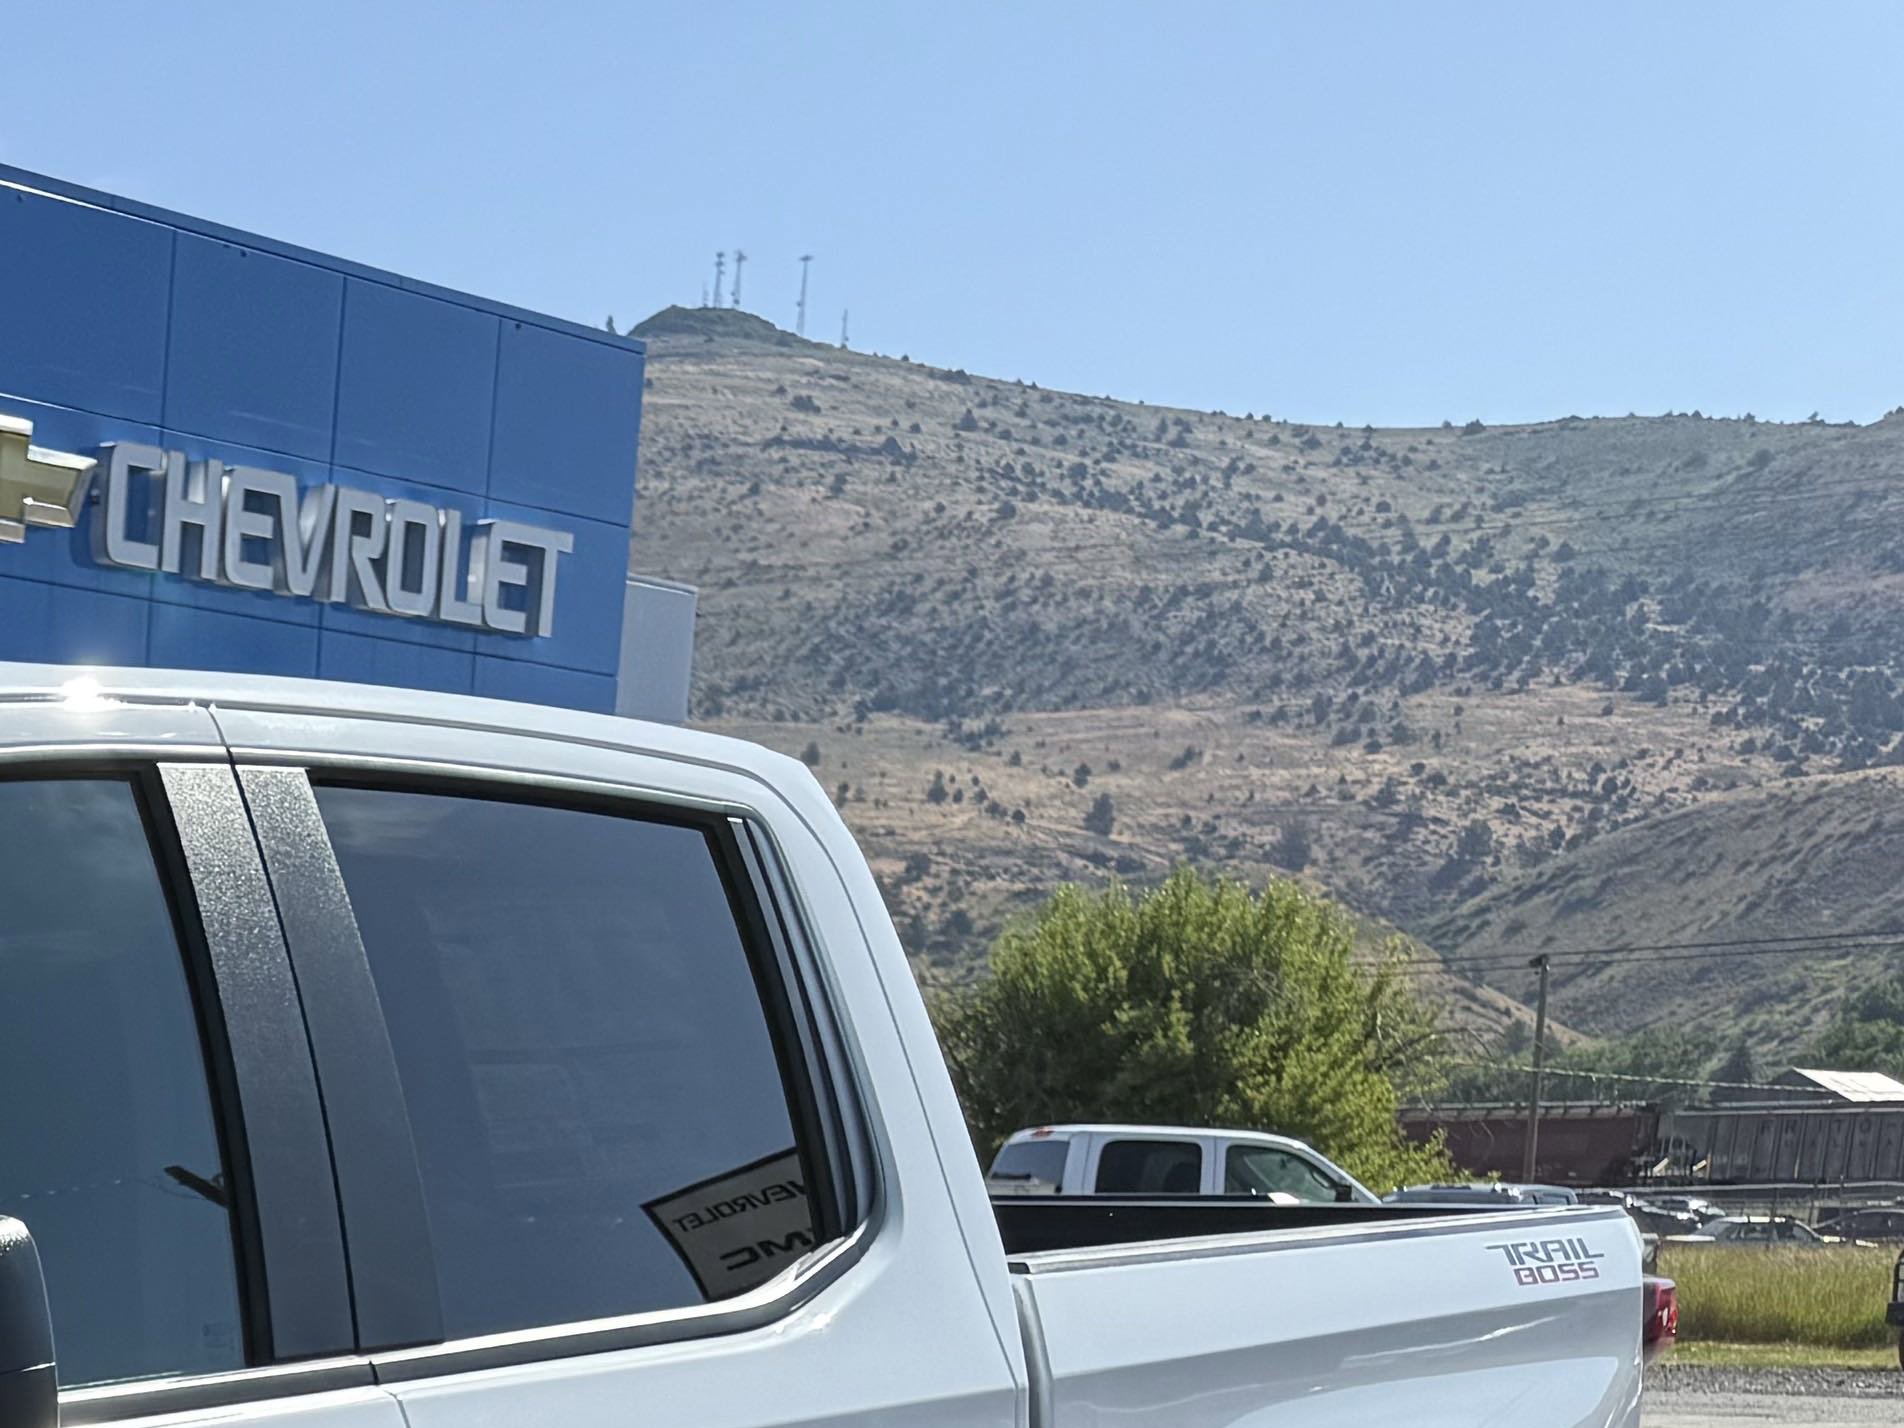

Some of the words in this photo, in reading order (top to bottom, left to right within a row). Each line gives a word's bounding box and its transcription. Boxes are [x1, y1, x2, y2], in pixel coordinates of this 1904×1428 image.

[94, 441, 574, 637] CHEVROLET
[1485, 1238, 1604, 1266] TRAIL
[1513, 1262, 1600, 1286] BOSS
